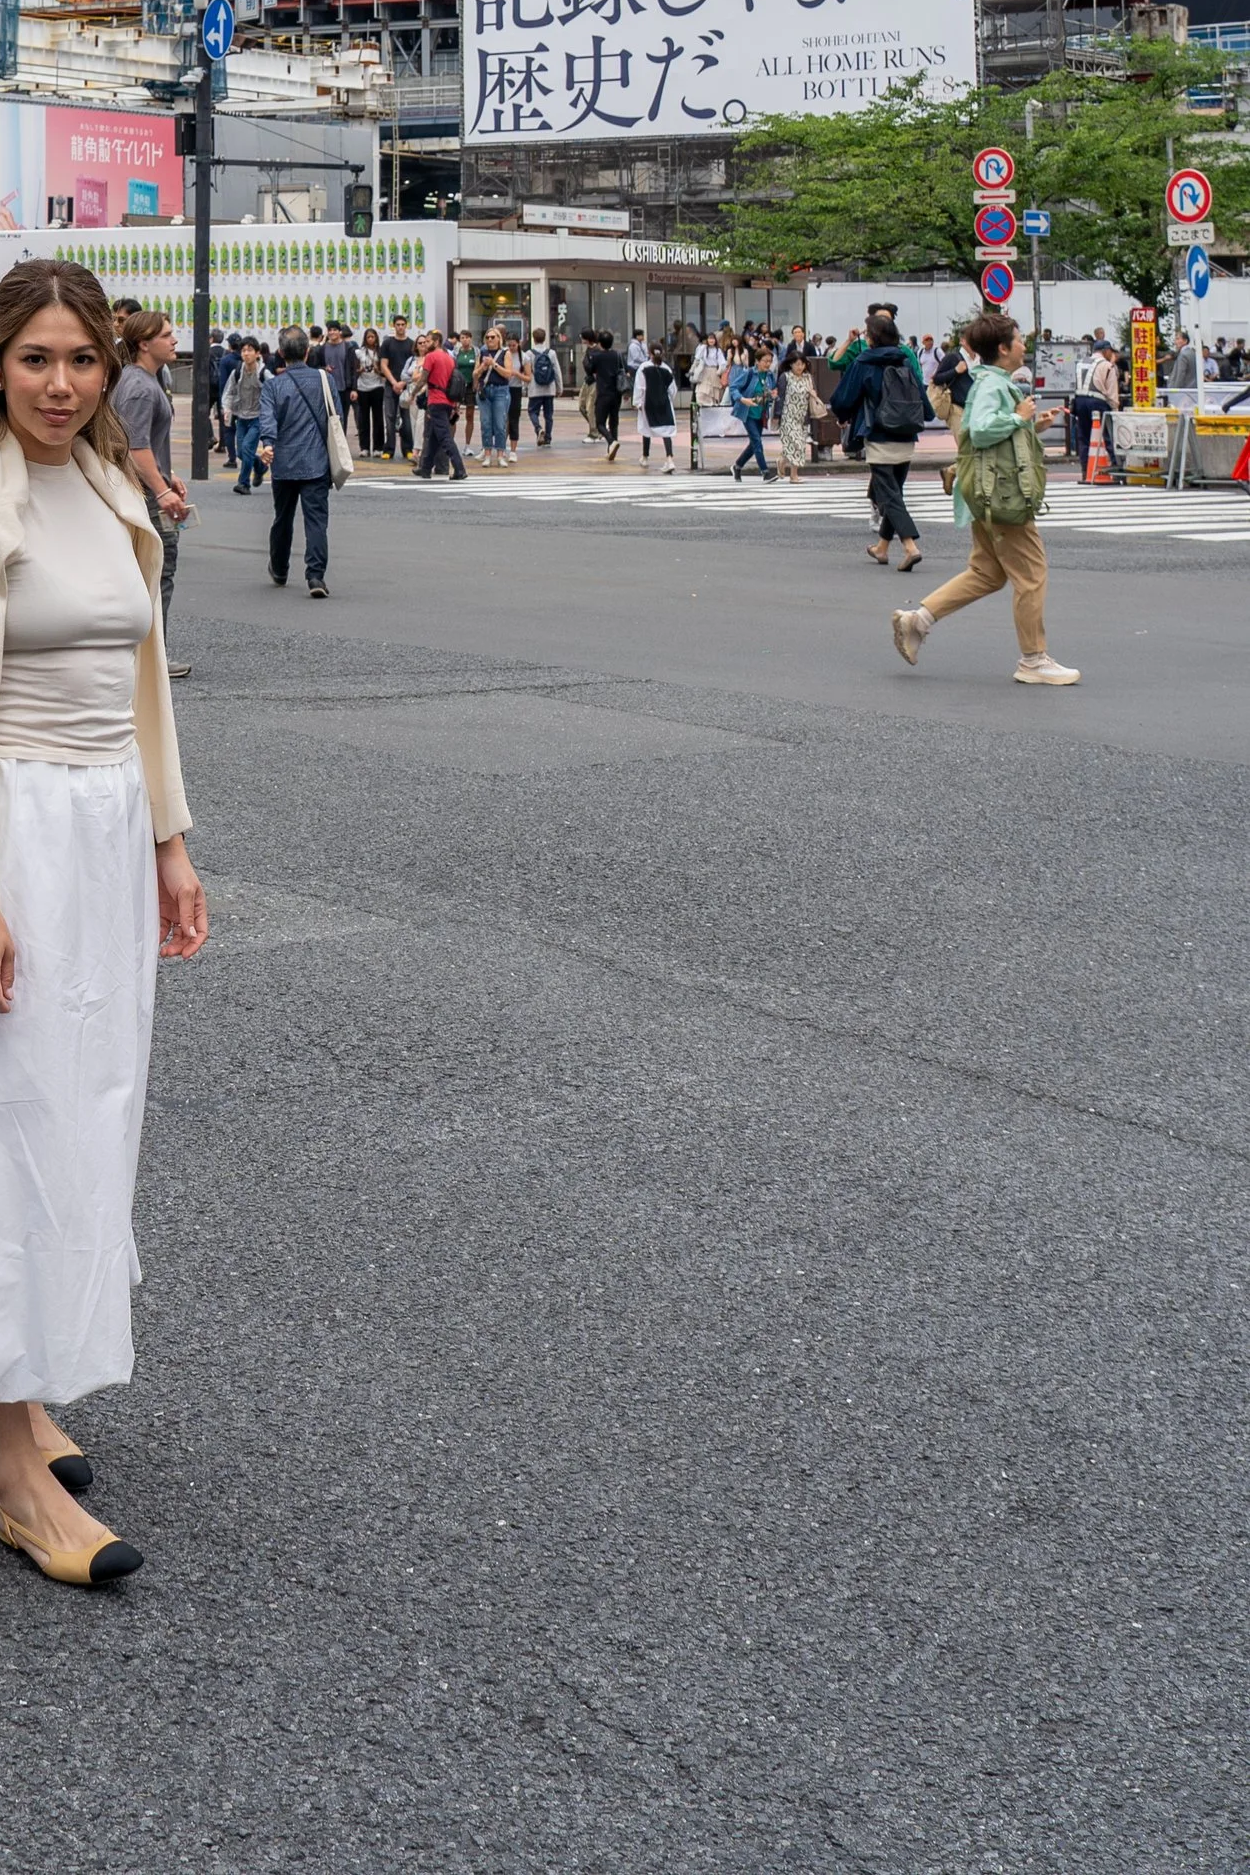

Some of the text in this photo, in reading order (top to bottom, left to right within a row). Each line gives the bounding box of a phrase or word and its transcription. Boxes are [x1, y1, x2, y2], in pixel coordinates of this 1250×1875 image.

[802, 30, 901, 48] SHOHEI OHTANI
[755, 45, 946, 77] ALL HOME RUNS
[469, 29, 747, 135] 歴史だ。
[70, 134, 164, 168] 龍角散ダイレクト
[1171, 228, 1210, 242] ここまで
[667, 246, 700, 265] HACHI
[1132, 309, 1155, 322] バス停
[1133, 327, 1149, 406] 駐停車禁
